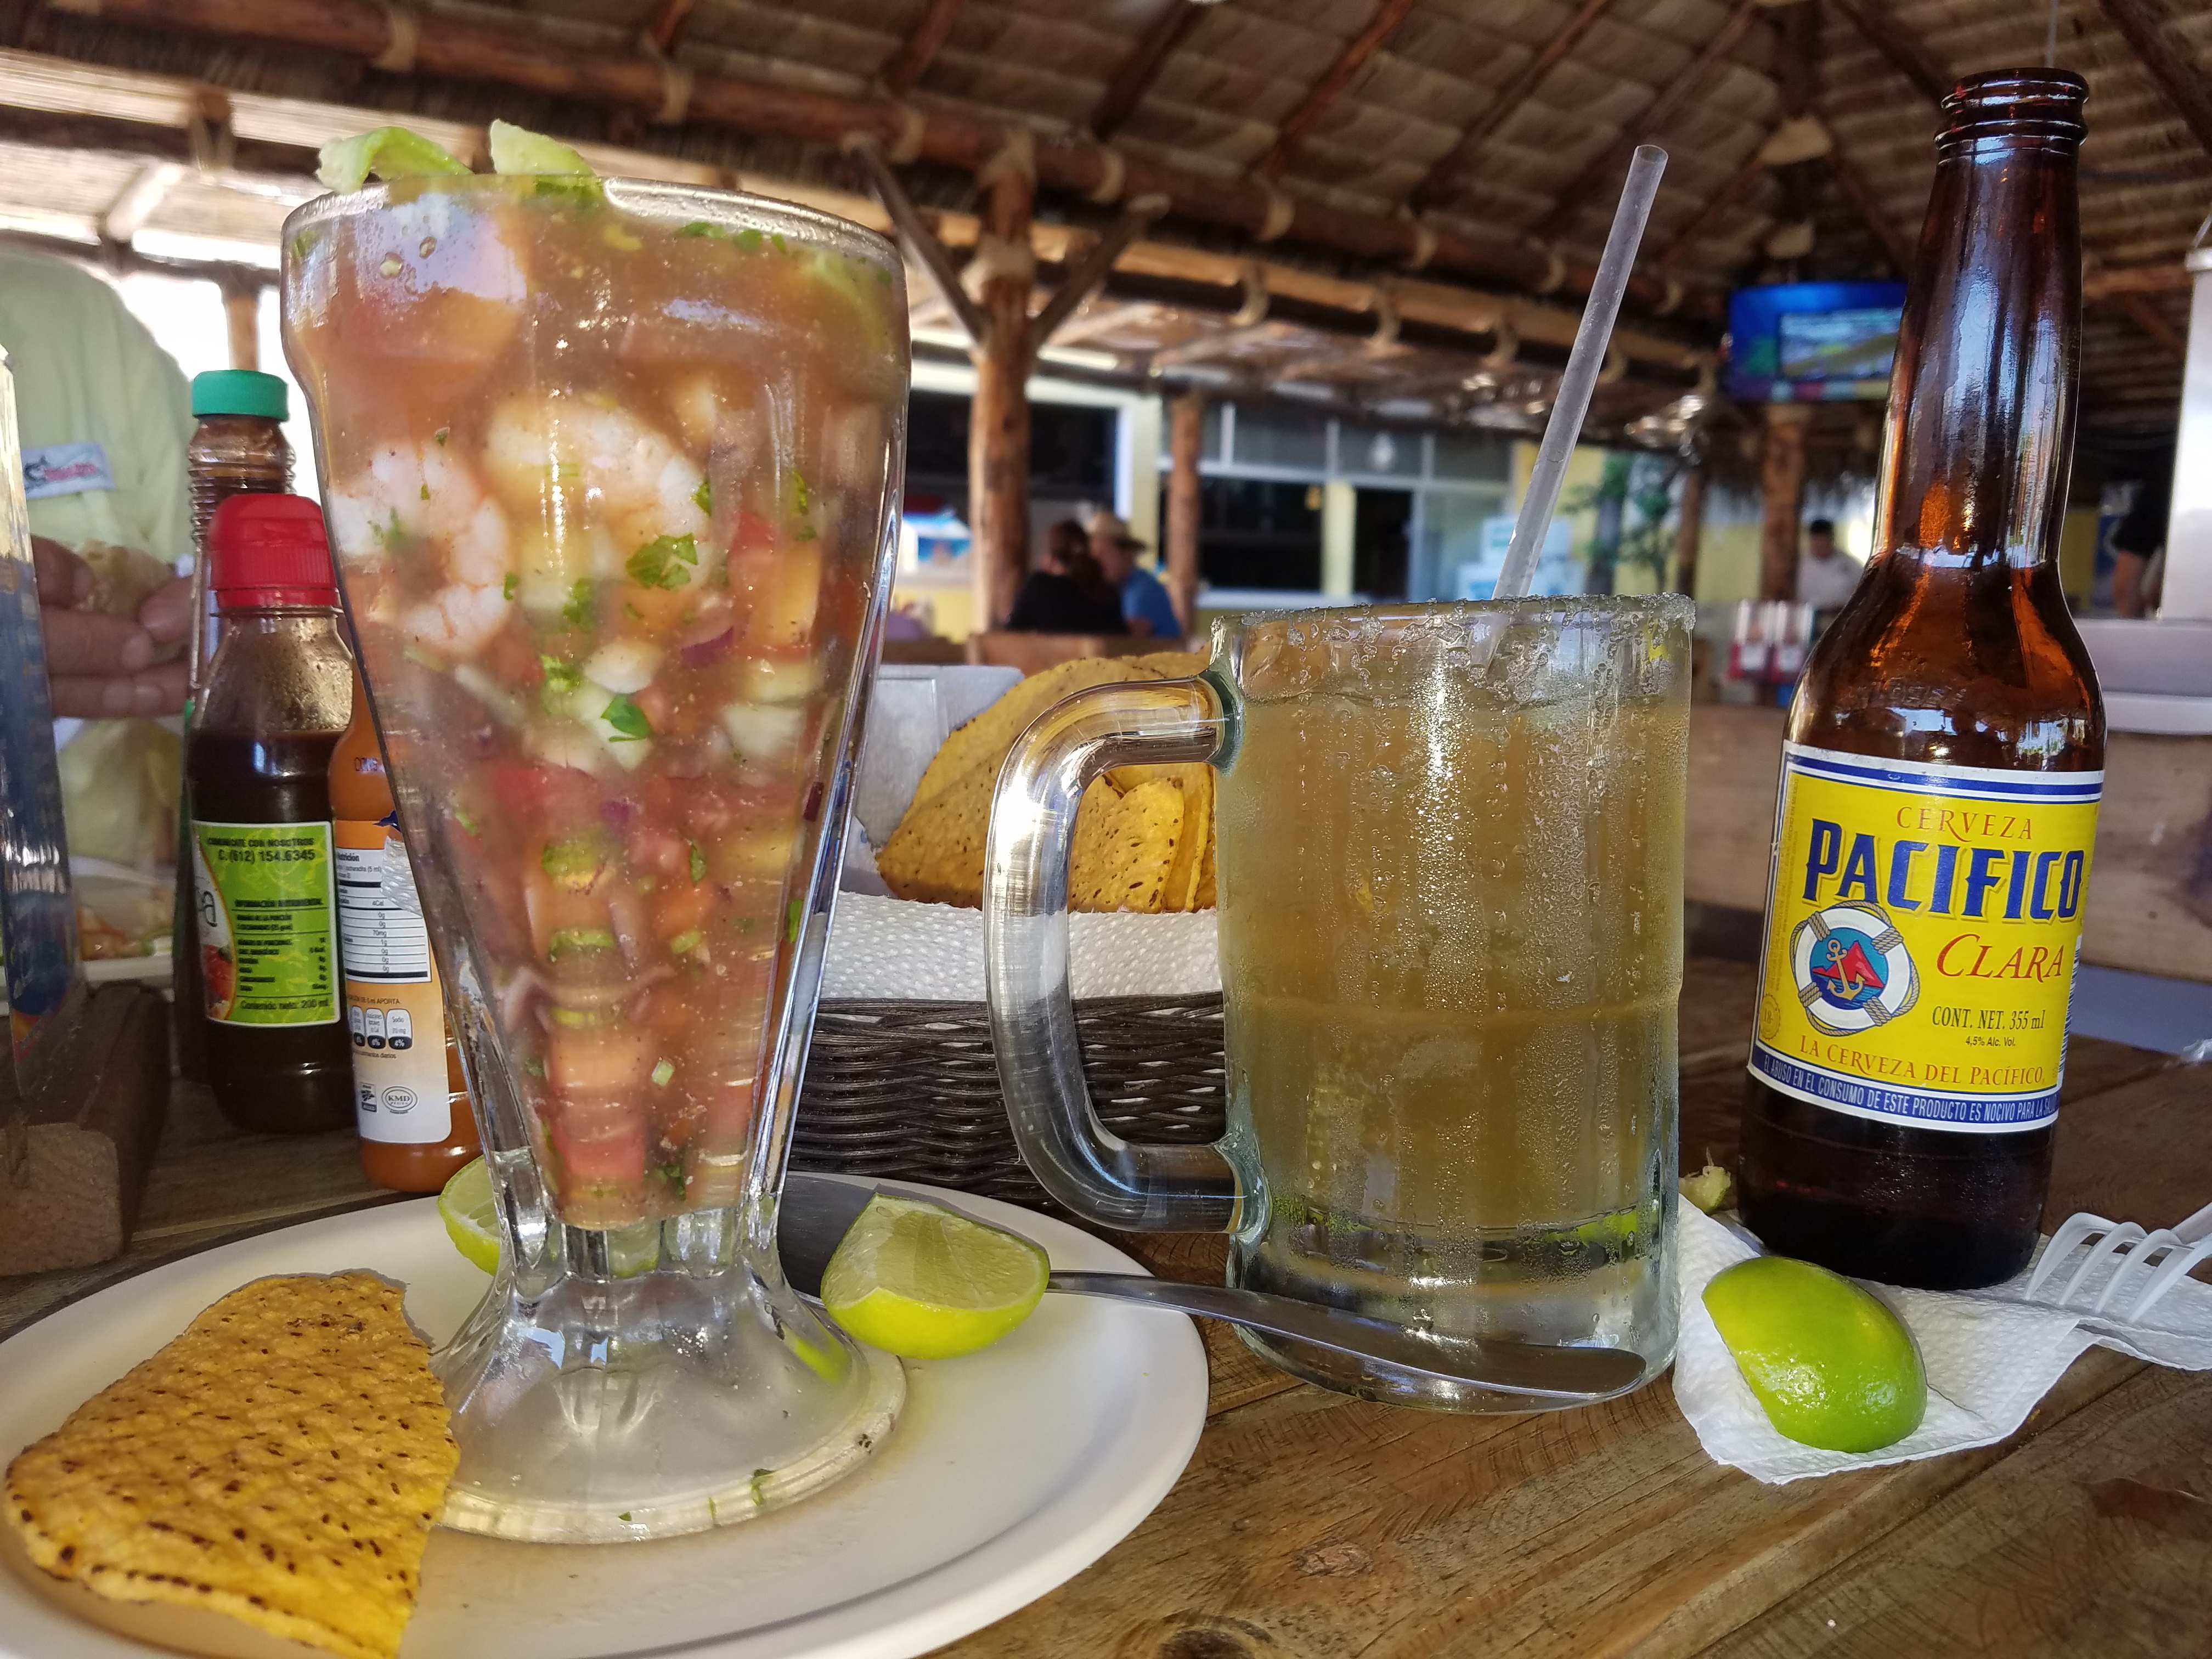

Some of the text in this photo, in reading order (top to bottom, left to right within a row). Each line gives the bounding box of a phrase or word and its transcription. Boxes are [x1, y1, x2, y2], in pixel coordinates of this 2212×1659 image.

[1897, 806, 2032, 842] CERVEZA
[258, 849, 315, 862] 154.6345
[1802, 818, 2085, 920] PACIFICO
[1937, 933, 2064, 983] CLARA
[1932, 1006, 2046, 1030] CONT. NET. 355 ml
[1799, 1035, 1820, 1057] LA
[1827, 1044, 1916, 1079] CERVEZA
[1924, 1063, 1961, 1084] DEL
[1968, 1065, 2043, 1086] PACÍFICO
[1965, 1036, 2016, 1047] 4,5% Alc. Vol.
[1764, 1054, 1770, 1073] EL
[1771, 1059, 1792, 1084] ABUSO
[1793, 1068, 1804, 1088] EN
[1805, 1073, 1815, 1092] EL
[1818, 1076, 1865, 1105] CONSUMO
[1867, 1089, 1882, 1110] DE
[1883, 1092, 1910, 1115] ESTE
[1912, 1096, 1967, 1121] PRODUCTO
[1968, 1102, 1981, 1121] ES
[1983, 1102, 2016, 1122] NOCIVO
[2016, 1101, 2035, 1121] PARA
[2035, 1098, 2044, 1118] LA
